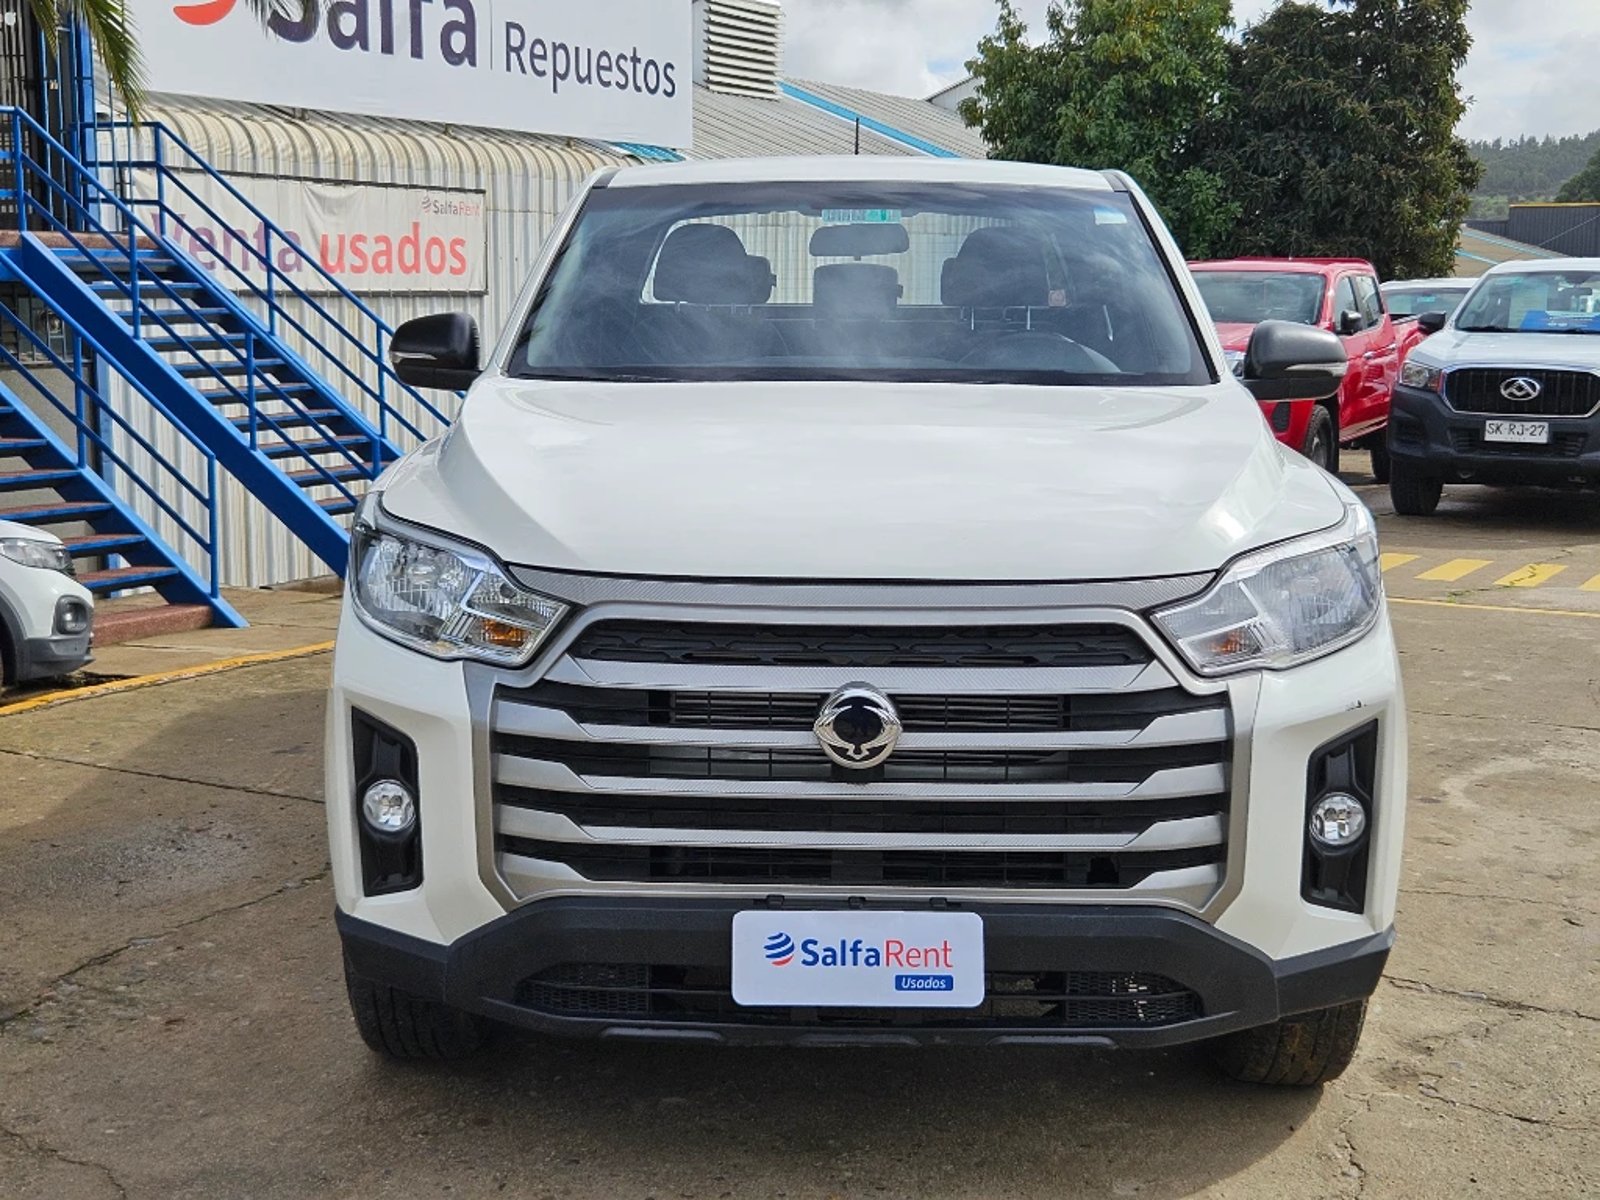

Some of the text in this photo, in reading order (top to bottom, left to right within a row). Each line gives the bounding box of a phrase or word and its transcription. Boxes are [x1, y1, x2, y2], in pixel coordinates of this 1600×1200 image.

[505, 21, 676, 97] Repuestos
[320, 222, 467, 275] usados
[801, 939, 953, 968] SalfaRent
[901, 977, 946, 989] Usados
